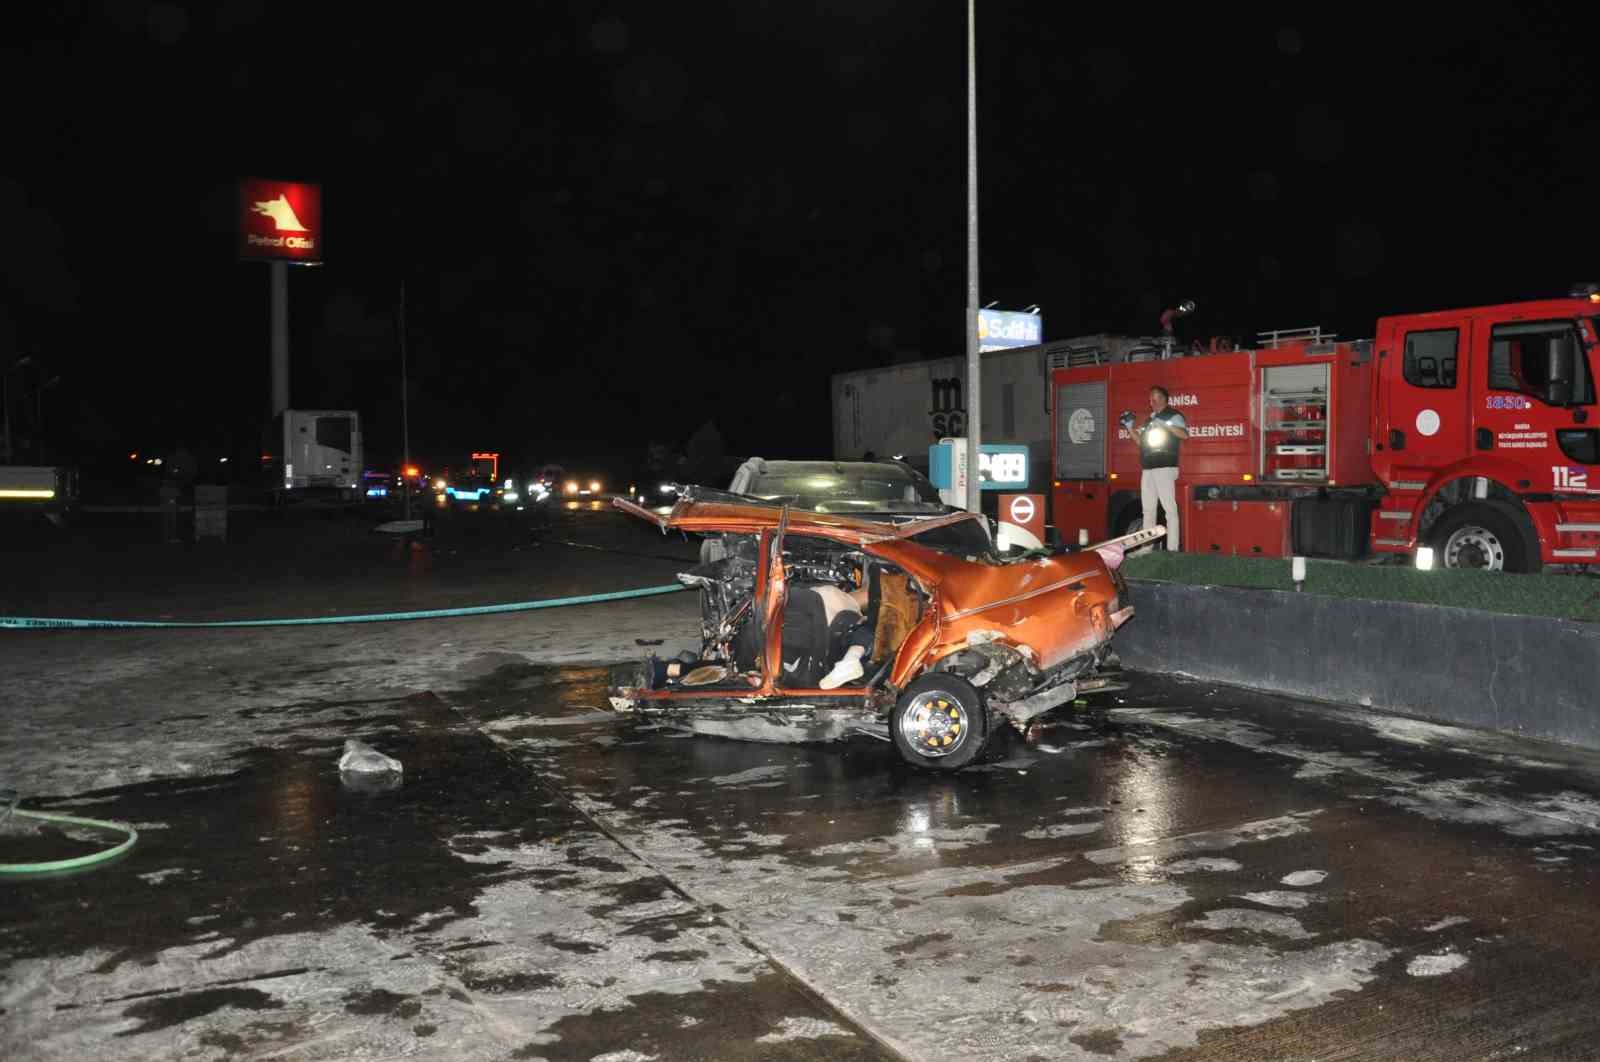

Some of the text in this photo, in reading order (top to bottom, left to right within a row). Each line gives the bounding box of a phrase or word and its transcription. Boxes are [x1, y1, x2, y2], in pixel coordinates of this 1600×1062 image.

[1167, 393, 1199, 407] ANİSA
[1187, 423, 1245, 438] ELEDİYESİ
[1551, 465, 1588, 488] 112
